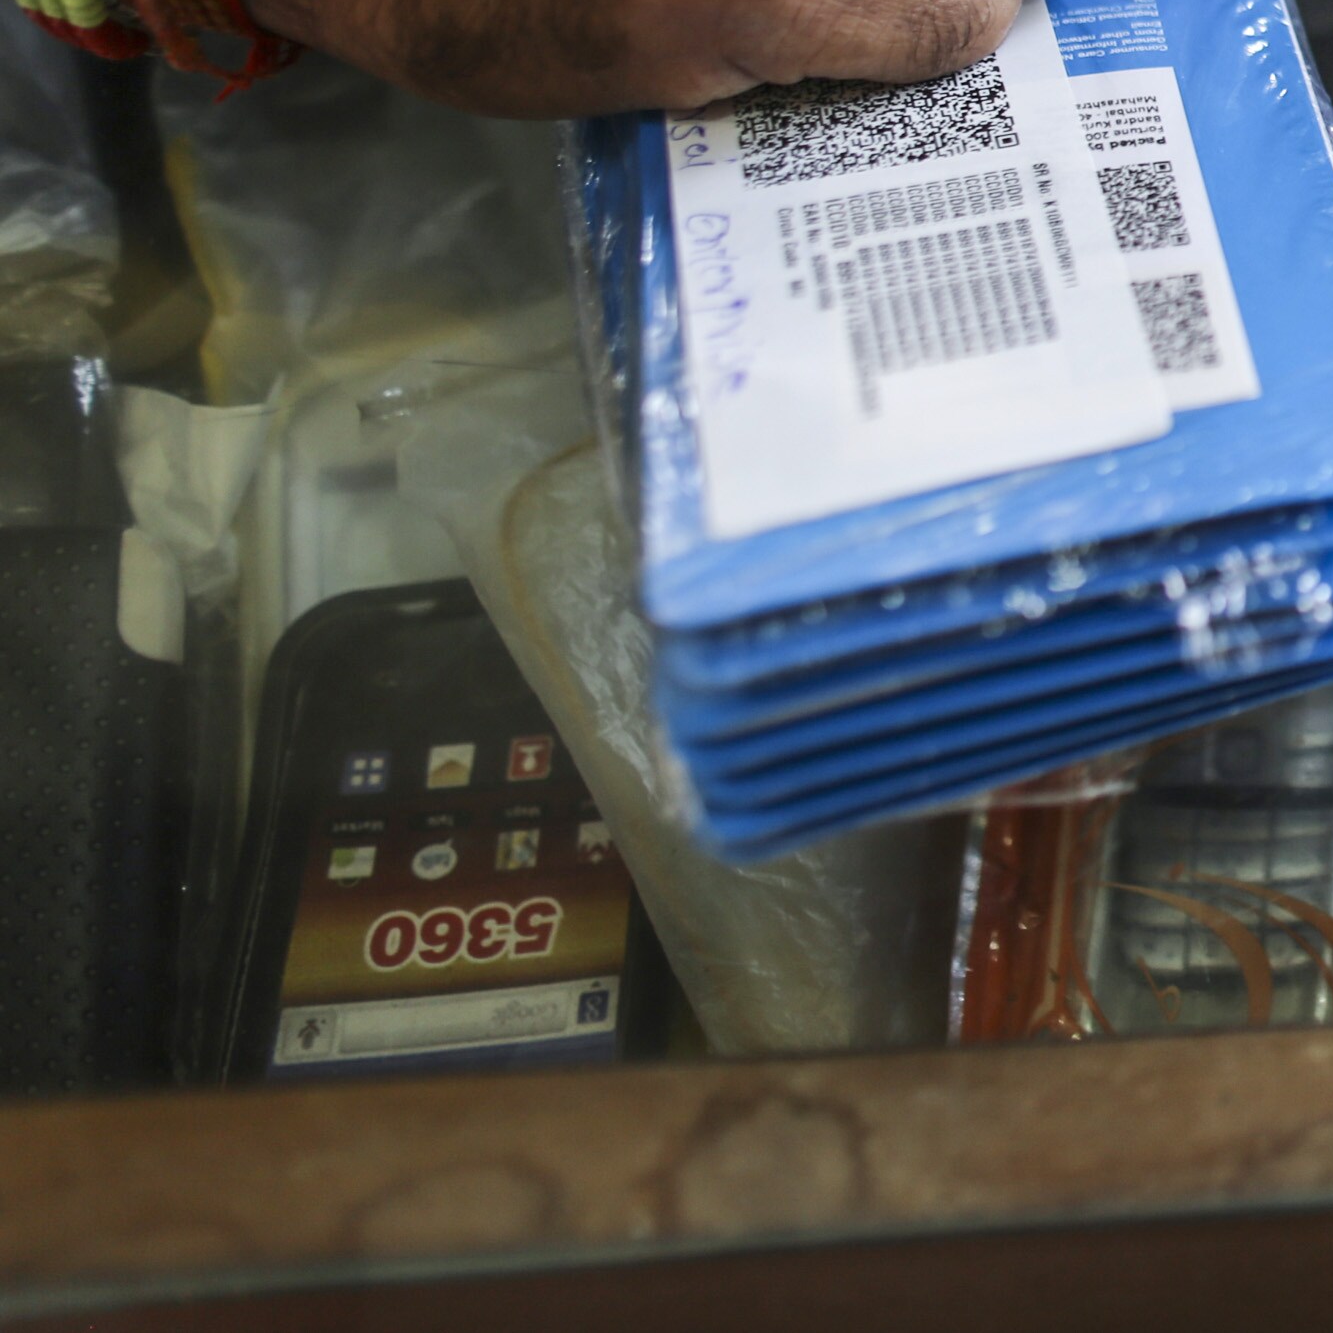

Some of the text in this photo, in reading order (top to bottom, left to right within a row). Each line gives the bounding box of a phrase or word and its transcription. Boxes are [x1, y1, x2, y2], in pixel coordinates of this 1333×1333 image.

[1078, 49, 1105, 58] Care
[1109, 45, 1168, 54] Consumer
[1106, 105, 1159, 118] Mumbai
[1115, 115, 1161, 125] Bandra
[1114, 125, 1164, 136] Fortune
[1110, 136, 1166, 150] Packed
[1033, 162, 1050, 178] SR
[366, 899, 562, 970] 5360
